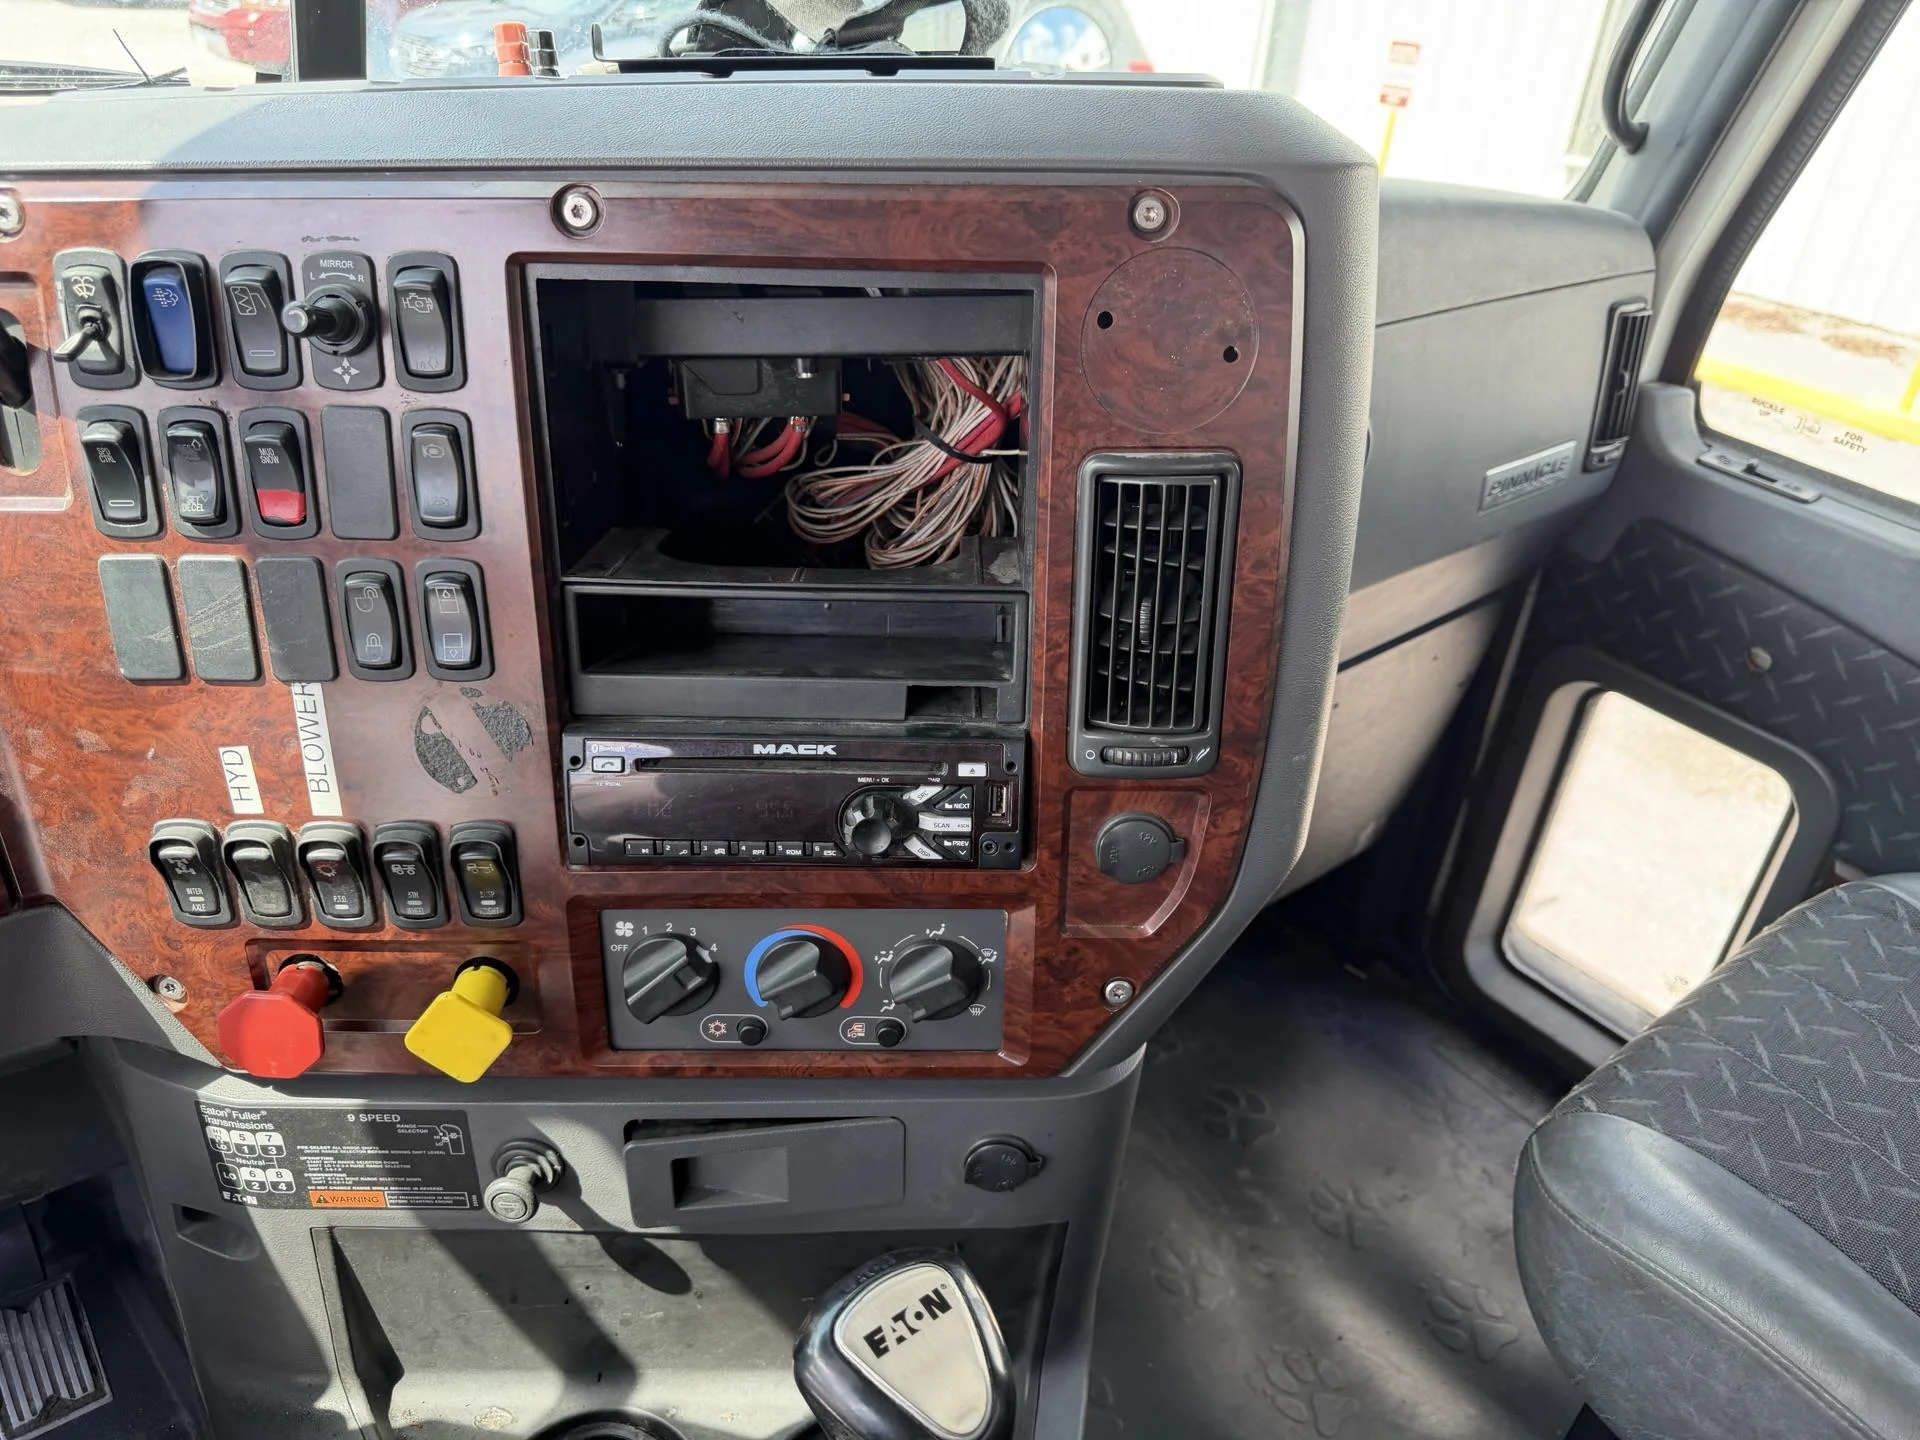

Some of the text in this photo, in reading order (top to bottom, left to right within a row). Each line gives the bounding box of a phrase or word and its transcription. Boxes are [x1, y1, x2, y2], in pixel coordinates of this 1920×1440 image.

[320, 259, 353, 269] MIRROR
[310, 272, 316, 280] L
[1844, 431, 1863, 443] FOR
[1833, 436, 1868, 454] SAFETY
[258, 447, 275, 456] MUD
[260, 455, 280, 464] SNOW
[182, 503, 205, 512] DECEL
[294, 682, 331, 793] BLOWER
[753, 744, 837, 755] MACK
[222, 750, 253, 801] HYD
[186, 887, 203, 895] INTER
[191, 903, 207, 912] AXLE
[642, 926, 648, 935] 1
[666, 922, 673, 932] 2
[689, 927, 697, 936] 3
[610, 944, 629, 952] OFF
[710, 943, 718, 952] 4
[202, 1115, 275, 1130] Transmissions
[347, 1114, 401, 1122] 9 SPEED
[239, 1133, 246, 1141] 5
[268, 1147, 277, 1155] 3
[235, 1157, 265, 1166] Neutral
[223, 1171, 237, 1180] LO
[249, 1170, 257, 1178] 6
[251, 1182, 260, 1190] 2
[278, 1182, 287, 1190] 4
[329, 1195, 380, 1204] WARNING
